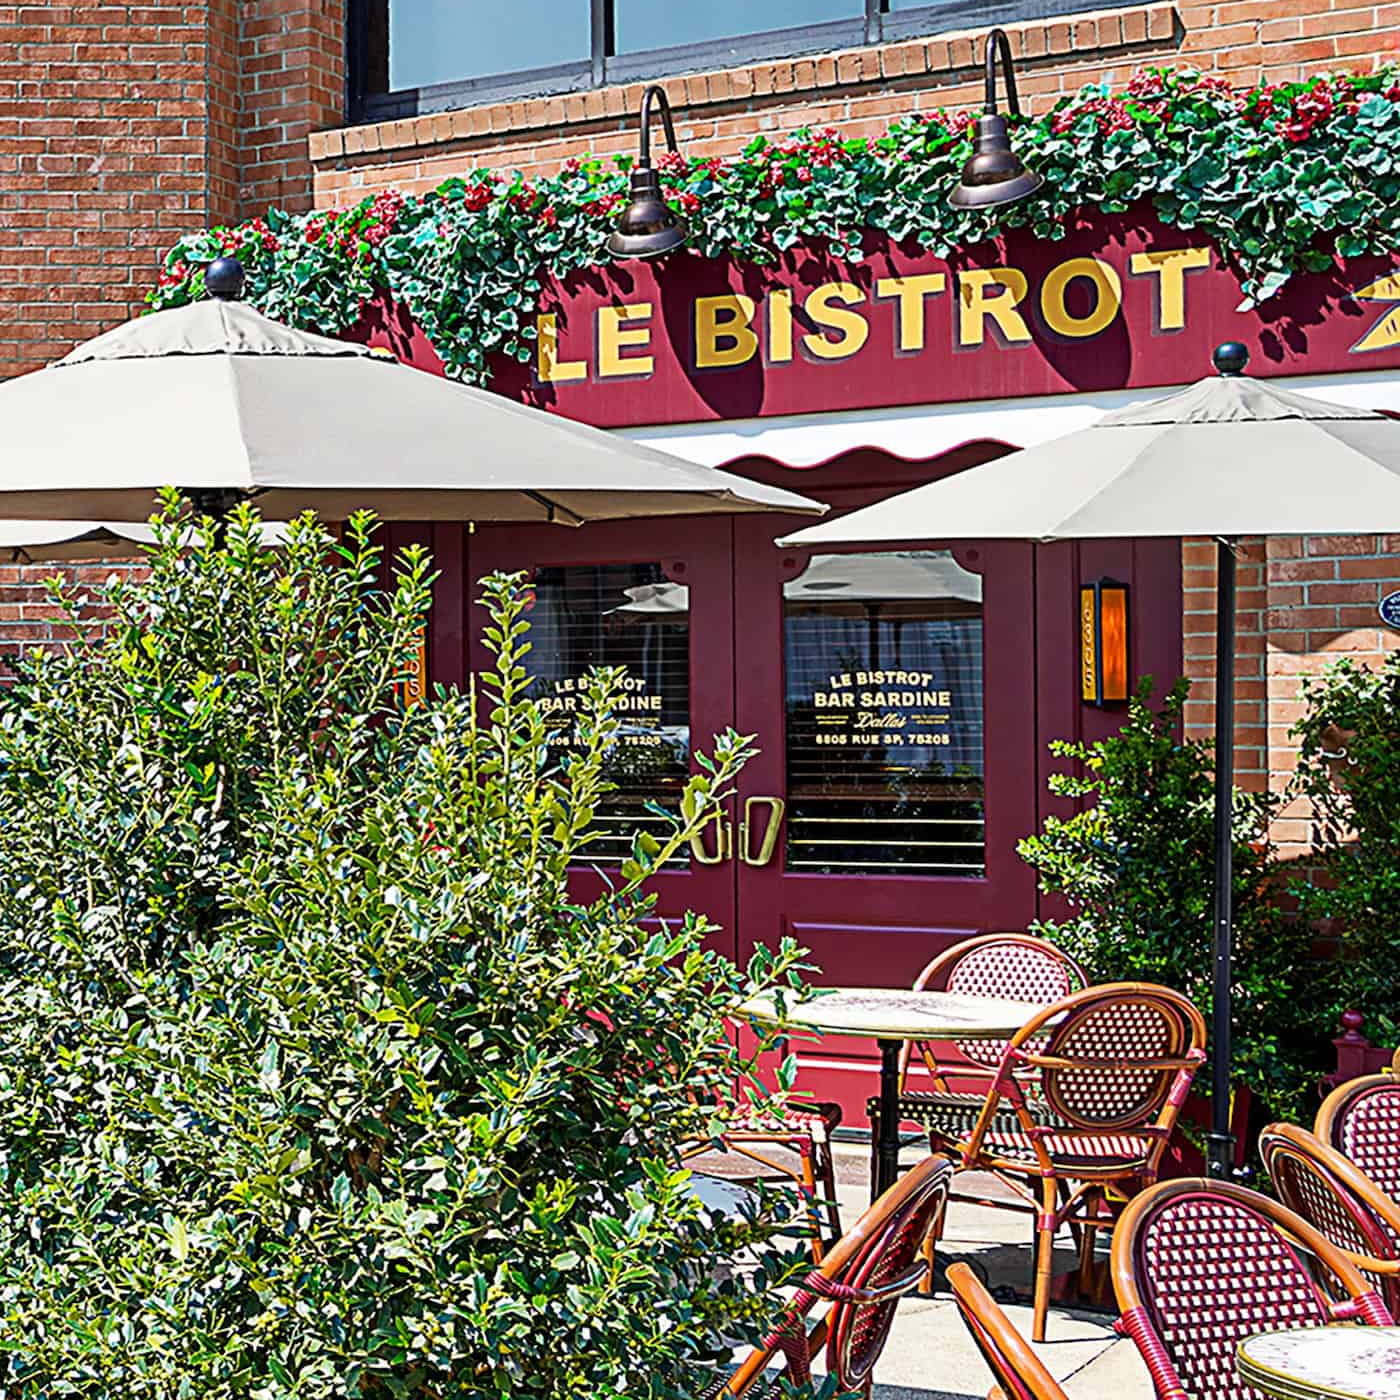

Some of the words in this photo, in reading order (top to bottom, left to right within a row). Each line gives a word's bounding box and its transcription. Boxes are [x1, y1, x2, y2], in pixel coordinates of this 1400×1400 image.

[538, 302, 654, 384] LE
[694, 247, 1211, 368] BISTROT
[555, 679, 575, 693] LE
[830, 673, 852, 689] LE
[856, 670, 933, 688] BISTROT
[541, 697, 576, 711] BAR
[814, 691, 856, 707] BAR
[860, 691, 951, 707] SARDINE
[852, 734, 880, 745] RUE
